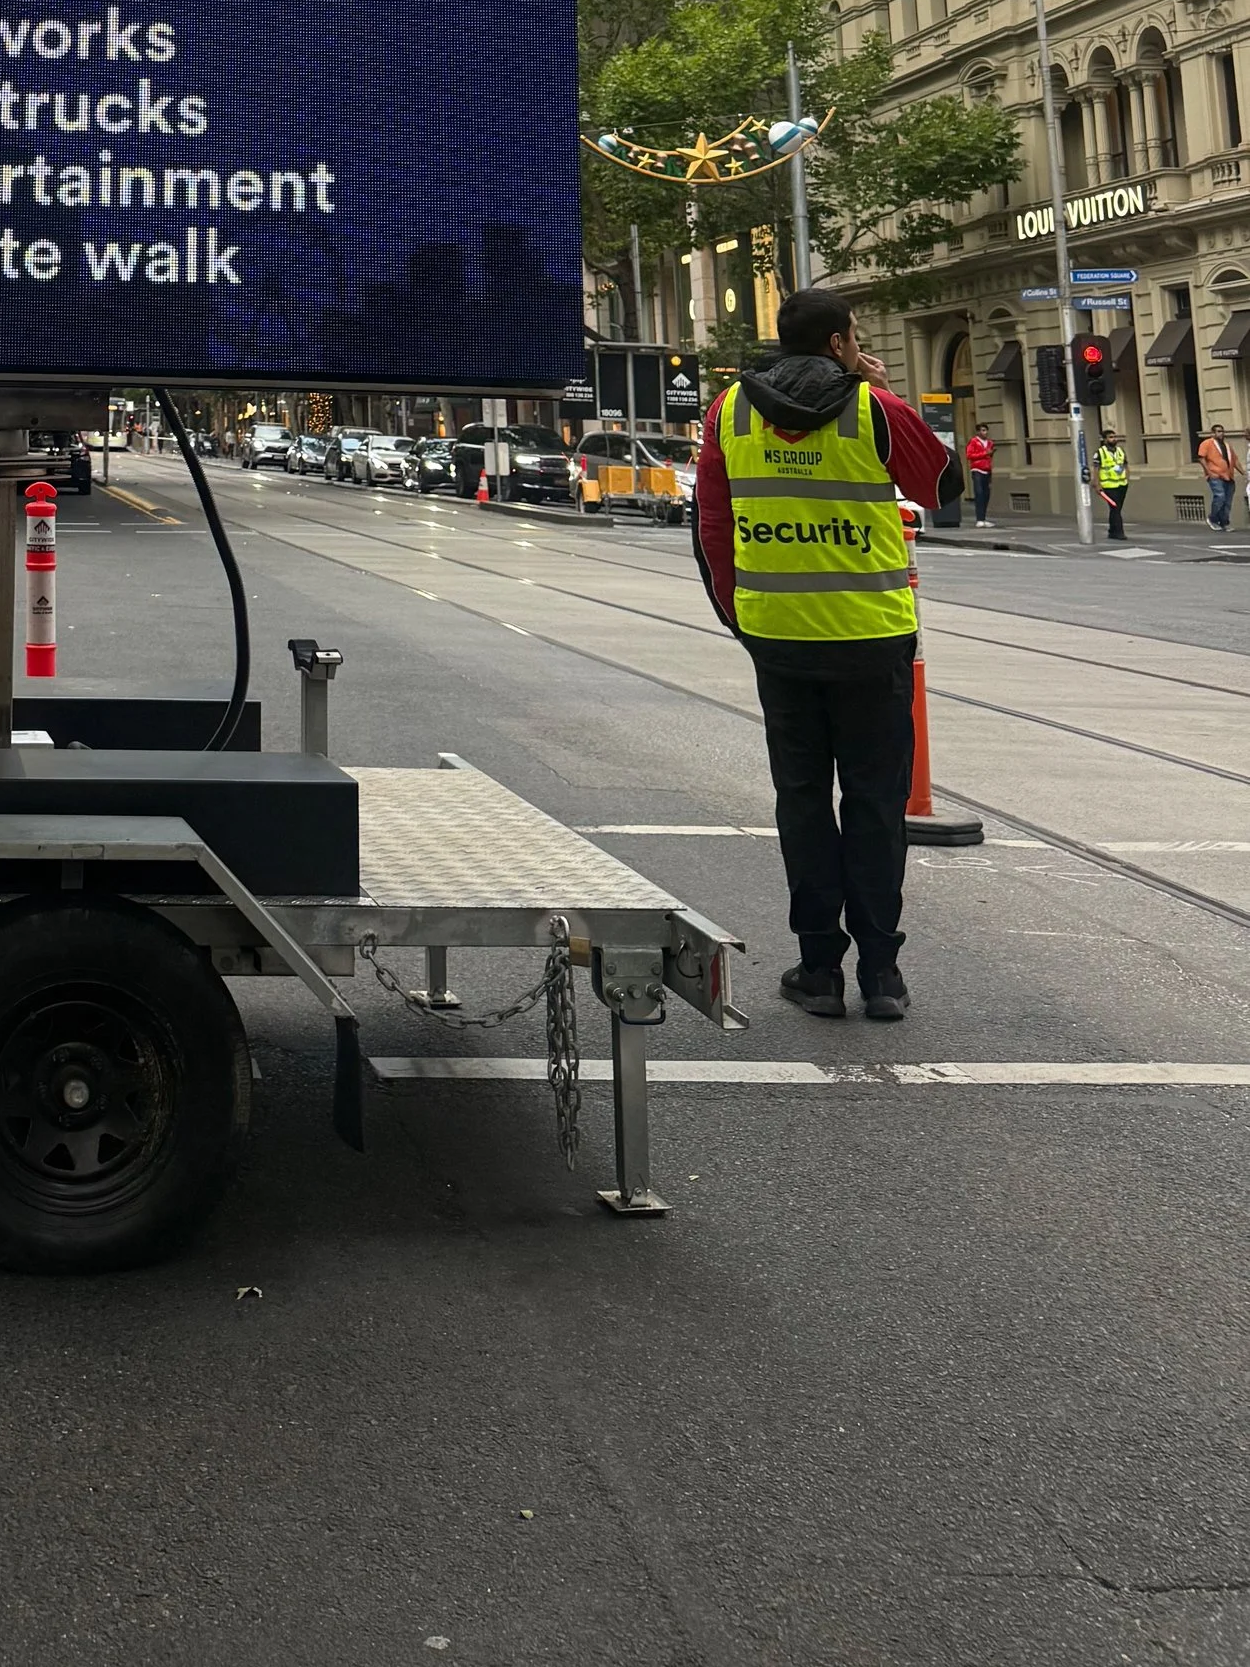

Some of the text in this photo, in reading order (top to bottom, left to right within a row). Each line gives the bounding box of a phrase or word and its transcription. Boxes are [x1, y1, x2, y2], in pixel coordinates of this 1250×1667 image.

[1017, 185, 1145, 240] LOUI VUITTON
[83, 227, 242, 284] walk
[1027, 288, 1048, 297] Collins
[1049, 287, 1057, 295] St
[1086, 298, 1127, 306] Russell St
[783, 450, 823, 466] GROUP
[777, 467, 813, 476] AUSTRALIA
[737, 515, 872, 554] Security
